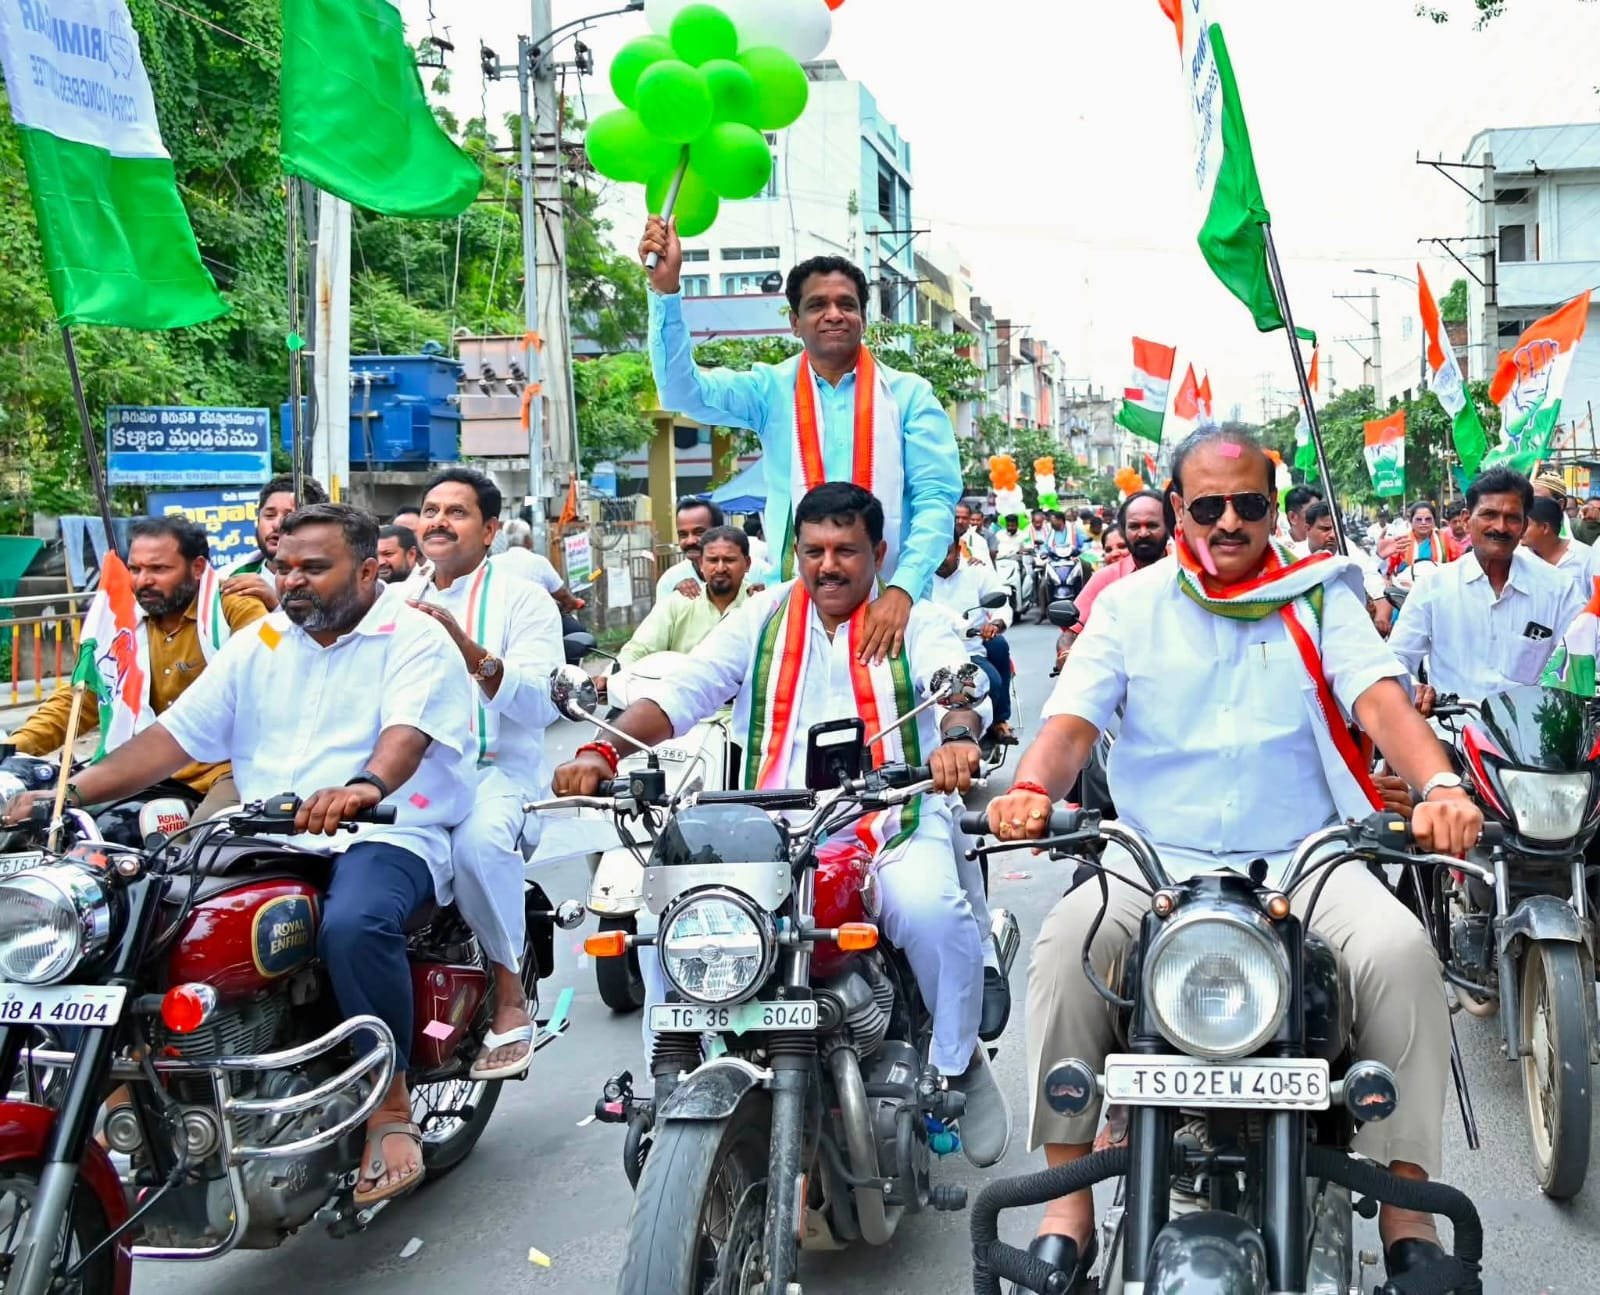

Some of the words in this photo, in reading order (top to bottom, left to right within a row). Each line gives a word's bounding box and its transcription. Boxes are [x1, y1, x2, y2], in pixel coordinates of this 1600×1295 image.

[156, 812, 184, 825] ROYAL
[272, 918, 305, 938] ROYAL
[269, 932, 309, 956] ENFIELD
[1, 1001, 23, 1019] 18
[28, 1001, 43, 1020] A
[50, 1002, 108, 1022] 4004
[671, 1008, 693, 1027] TG
[705, 1008, 729, 1027] 36
[763, 1006, 812, 1025] 6040
[1252, 1071, 1320, 1096] 4056
